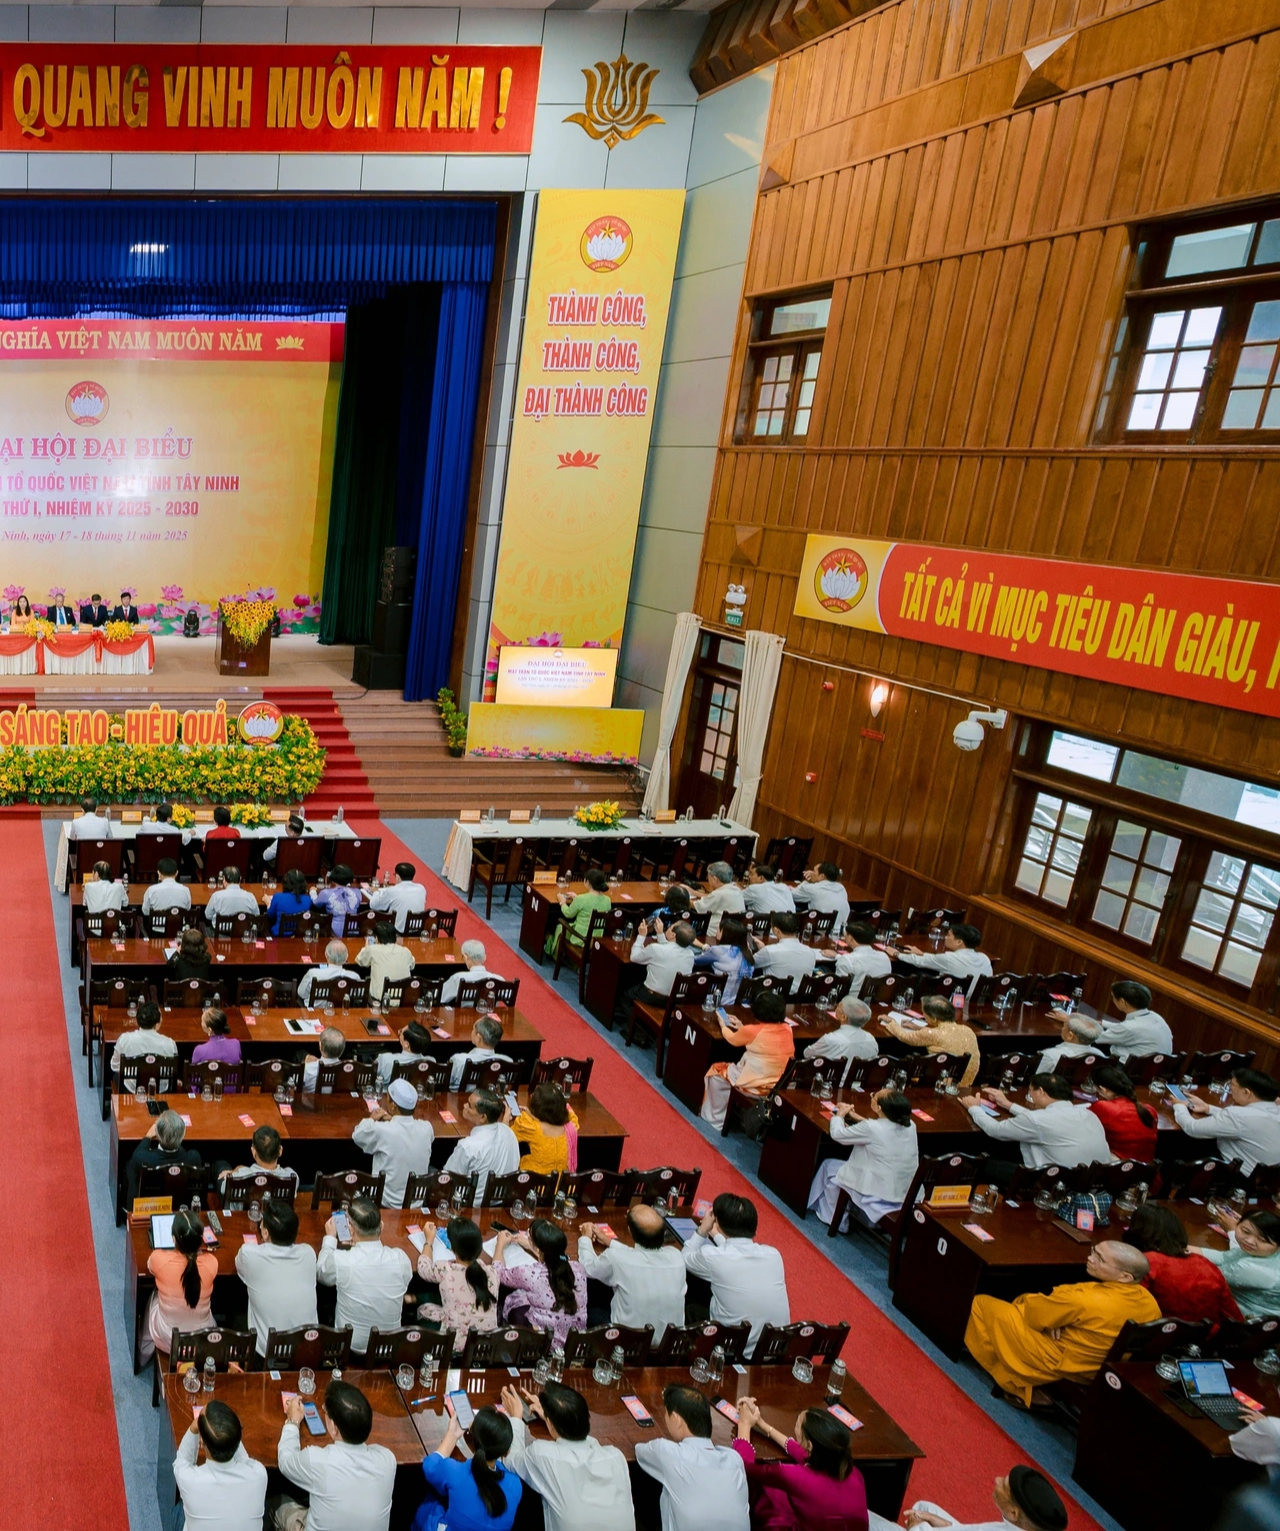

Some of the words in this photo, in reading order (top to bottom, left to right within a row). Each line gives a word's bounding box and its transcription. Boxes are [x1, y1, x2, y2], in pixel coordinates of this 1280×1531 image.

[14, 64, 149, 138] QUANG
[162, 65, 253, 127] VINH
[267, 51, 382, 130] MUÔN
[395, 54, 485, 129] NĂM
[548, 291, 598, 323] THÀNH
[602, 291, 646, 327] CÔNG,
[57, 326, 102, 355] VIỆT
[108, 331, 150, 350] NAM
[156, 327, 213, 350] MUÔN
[219, 328, 263, 351] NĂM
[543, 338, 592, 369] THÀNH
[595, 338, 640, 373] CÔNG,
[524, 387, 550, 420] ĐẠI
[554, 383, 603, 413] THÀNH
[606, 383, 647, 413] CÔNG
[31, 433, 76, 464] HỘI
[83, 437, 129, 464] ĐẠI
[134, 427, 193, 458] BIỂU
[7, 470, 24, 491] TỔ
[28, 470, 65, 491] QUỐC
[70, 473, 98, 494] VIỆT
[176, 473, 201, 491] TÂY
[205, 476, 239, 491] NINH
[3, 498, 30, 516] THỨ
[33, 501, 42, 519] I,
[46, 498, 91, 519] NHIỆM
[117, 501, 151, 516] 2025
[165, 501, 199, 516] 2030
[3, 531, 29, 542] Ninh,
[33, 532, 56, 544] ngày
[60, 531, 71, 541] 17
[81, 531, 91, 540] 18
[95, 530, 122, 542] tháng
[126, 531, 136, 540] 11
[140, 530, 161, 540] năm
[165, 530, 188, 540] 2025
[899, 557, 938, 622] TẤT
[935, 562, 968, 629] CẢ
[966, 573, 994, 633] VÌ
[990, 585, 1049, 652] MỤC
[1049, 585, 1103, 655] TIÊU
[1107, 593, 1177, 667] DÂN
[1174, 603, 1261, 693] GIÀU,
[0, 704, 60, 745] SÁNG
[183, 700, 227, 745] QUẢ
[532, 897, 539, 912] N
[685, 1025, 697, 1046] N
